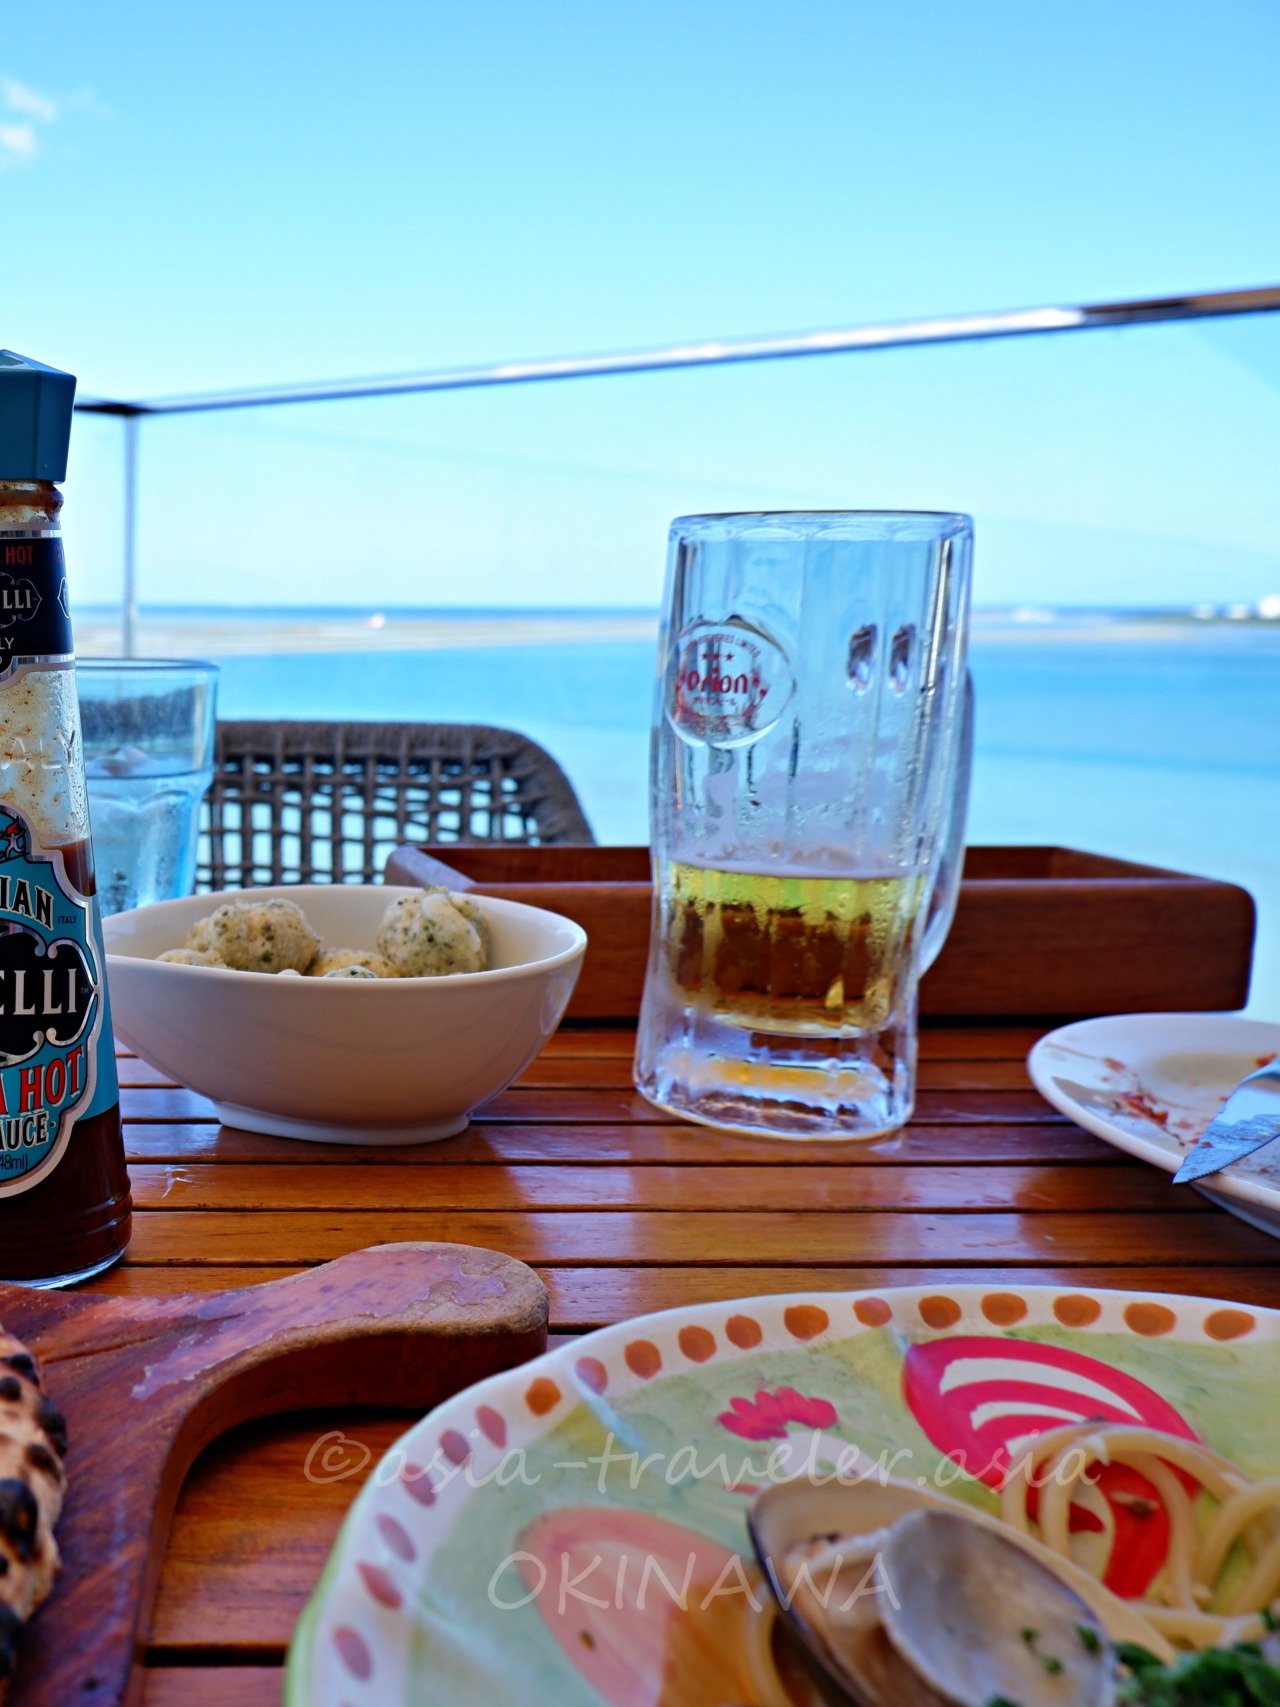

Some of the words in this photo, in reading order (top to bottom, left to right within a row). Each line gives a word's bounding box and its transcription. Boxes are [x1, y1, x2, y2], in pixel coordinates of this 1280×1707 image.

[6, 546, 34, 565] HOT
[57, 914, 78, 925] ITALY
[17, 1043, 85, 1115] HOT
